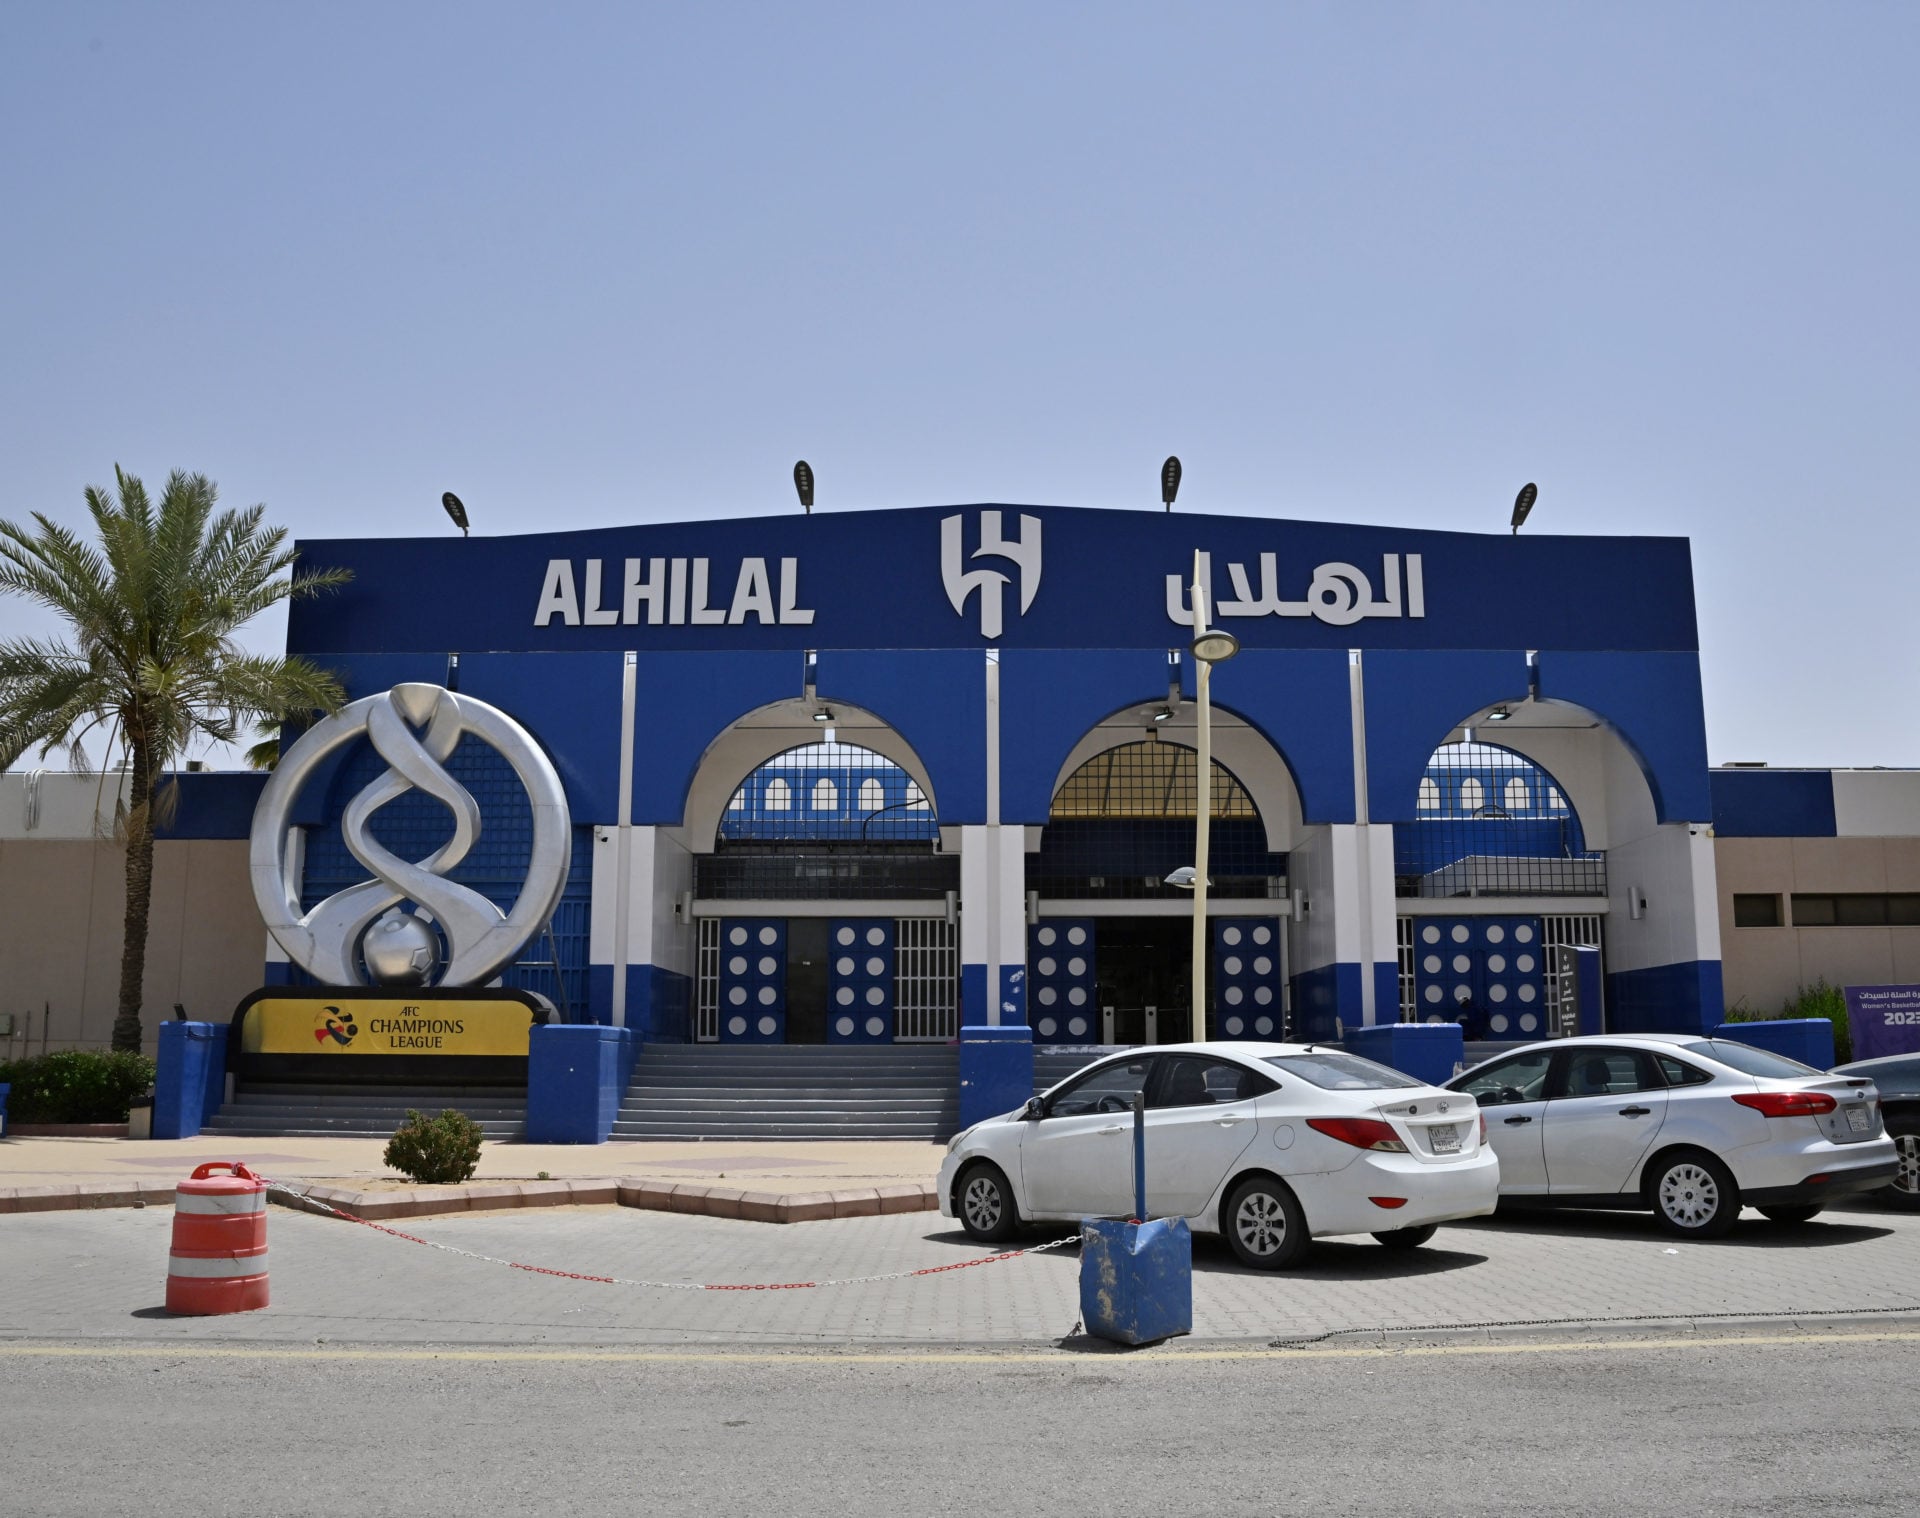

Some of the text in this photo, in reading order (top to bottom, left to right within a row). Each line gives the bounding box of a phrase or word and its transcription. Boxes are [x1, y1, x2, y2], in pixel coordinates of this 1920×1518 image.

[1166, 550, 1425, 626] الهلال
[1859, 991, 1890, 1000] للسيدات
[1890, 991, 1911, 999] السلة
[400, 1006, 420, 1017] AFC
[370, 1018, 464, 1034] CHAMPIONS
[390, 1035, 442, 1048] LEAGUE
